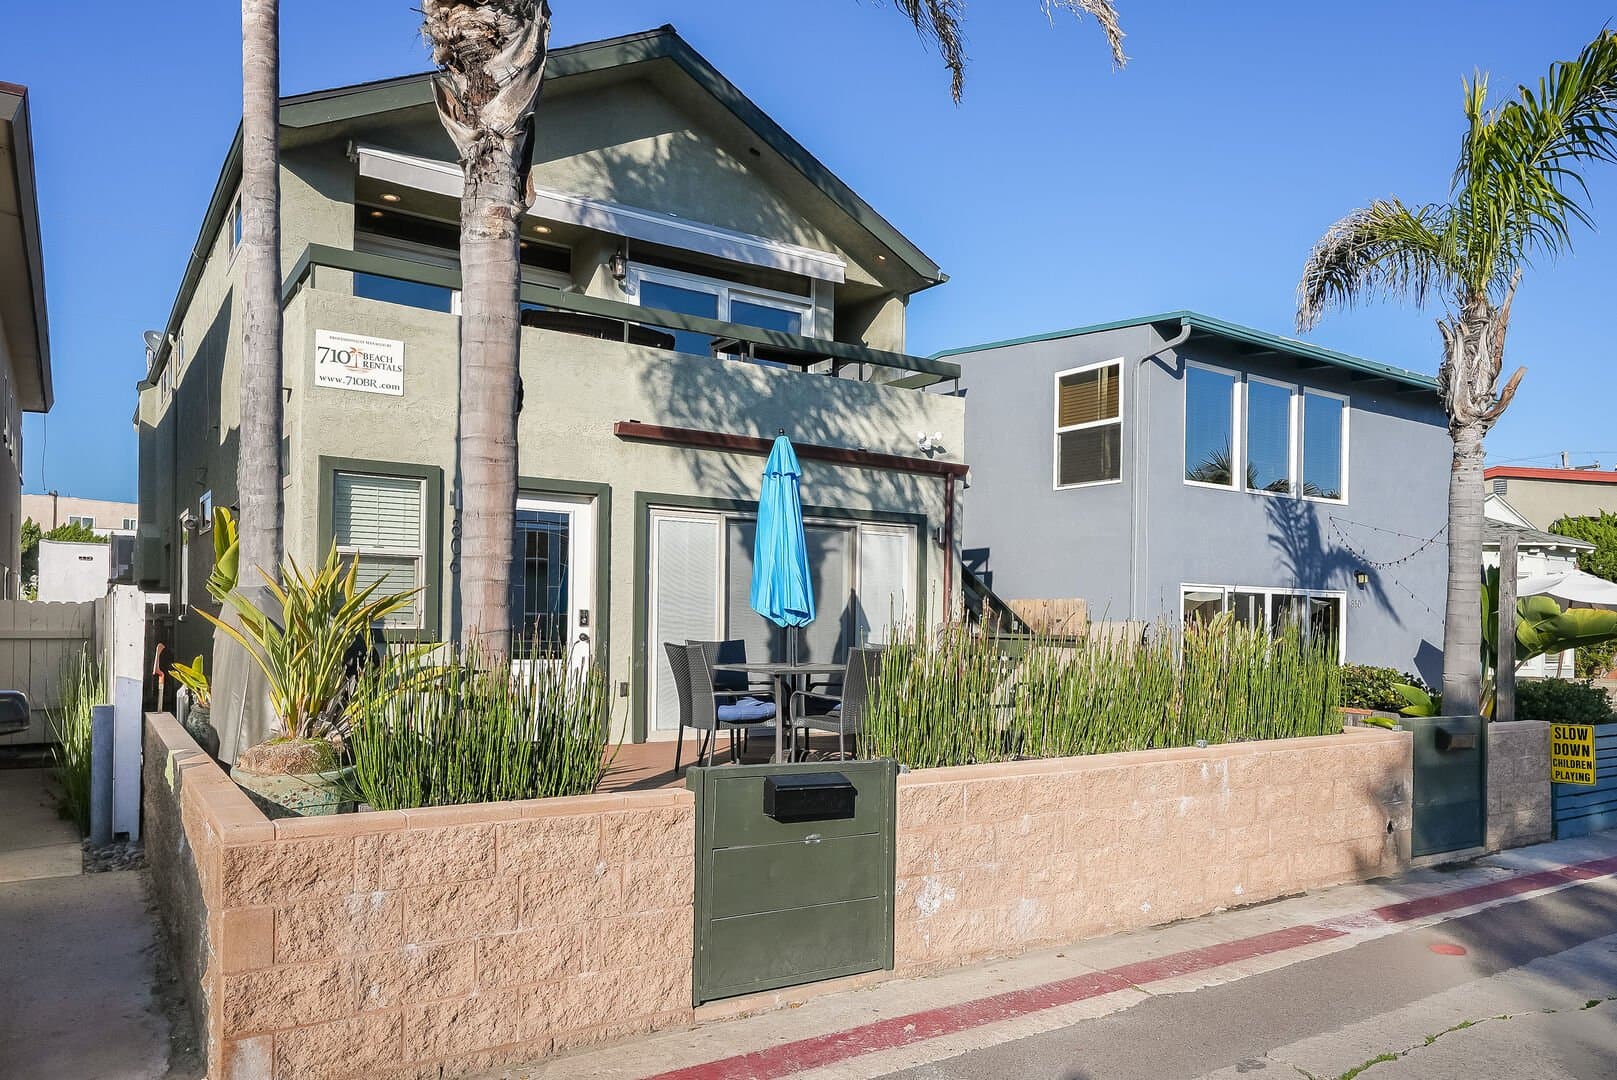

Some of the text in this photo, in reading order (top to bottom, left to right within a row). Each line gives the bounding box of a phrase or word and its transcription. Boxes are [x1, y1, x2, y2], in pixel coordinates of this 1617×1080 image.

[317, 346, 351, 365] 710
[363, 352, 393, 363] BEACH
[363, 361, 402, 372] RENTALS
[319, 375, 400, 391] www.710BR.com
[1554, 727, 1588, 740] SLOW
[1554, 742, 1590, 757] DOWN
[1552, 758, 1593, 770] CHILDREN
[1555, 770, 1591, 782] PLAYING
